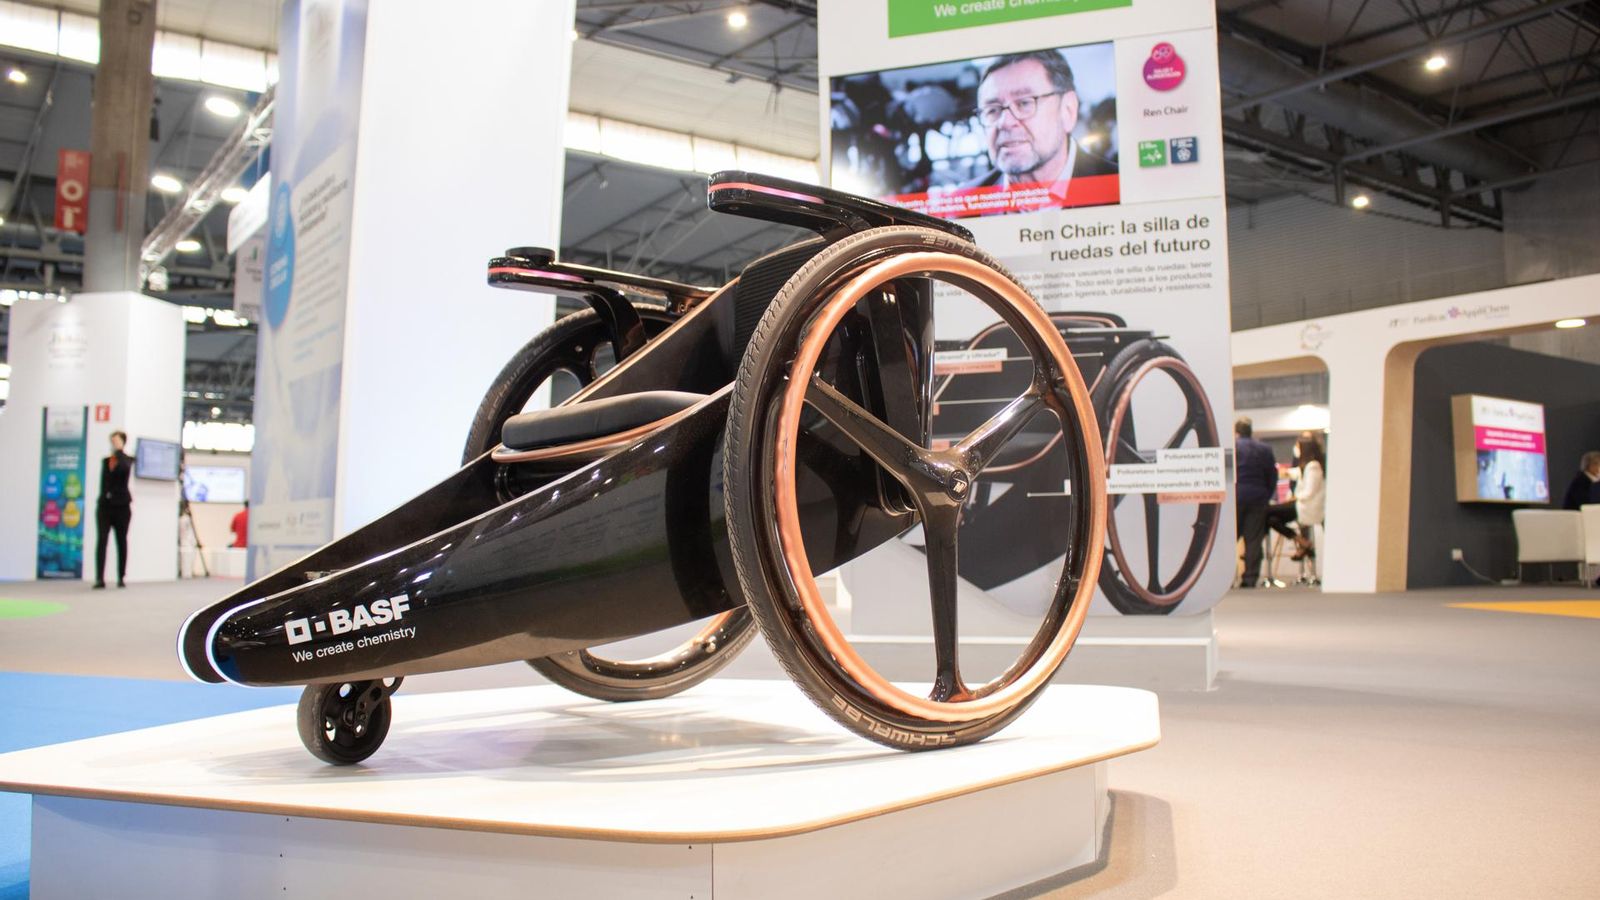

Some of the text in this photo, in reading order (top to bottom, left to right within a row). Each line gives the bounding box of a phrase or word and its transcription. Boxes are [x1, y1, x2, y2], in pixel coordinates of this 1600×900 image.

[933, 4, 957, 18] We
[960, 0, 1005, 14] create
[1143, 106, 1188, 118] Ren Chair
[1019, 215, 1210, 243] Ren Chair: la silla de
[1050, 237, 1211, 261] ruedas del futuro
[1127, 265, 1143, 273] silla
[1170, 272, 1213, 282] productos
[328, 594, 410, 635] BASF
[292, 626, 416, 663] We create chemistry
[831, 693, 957, 746] SCHWALBE
